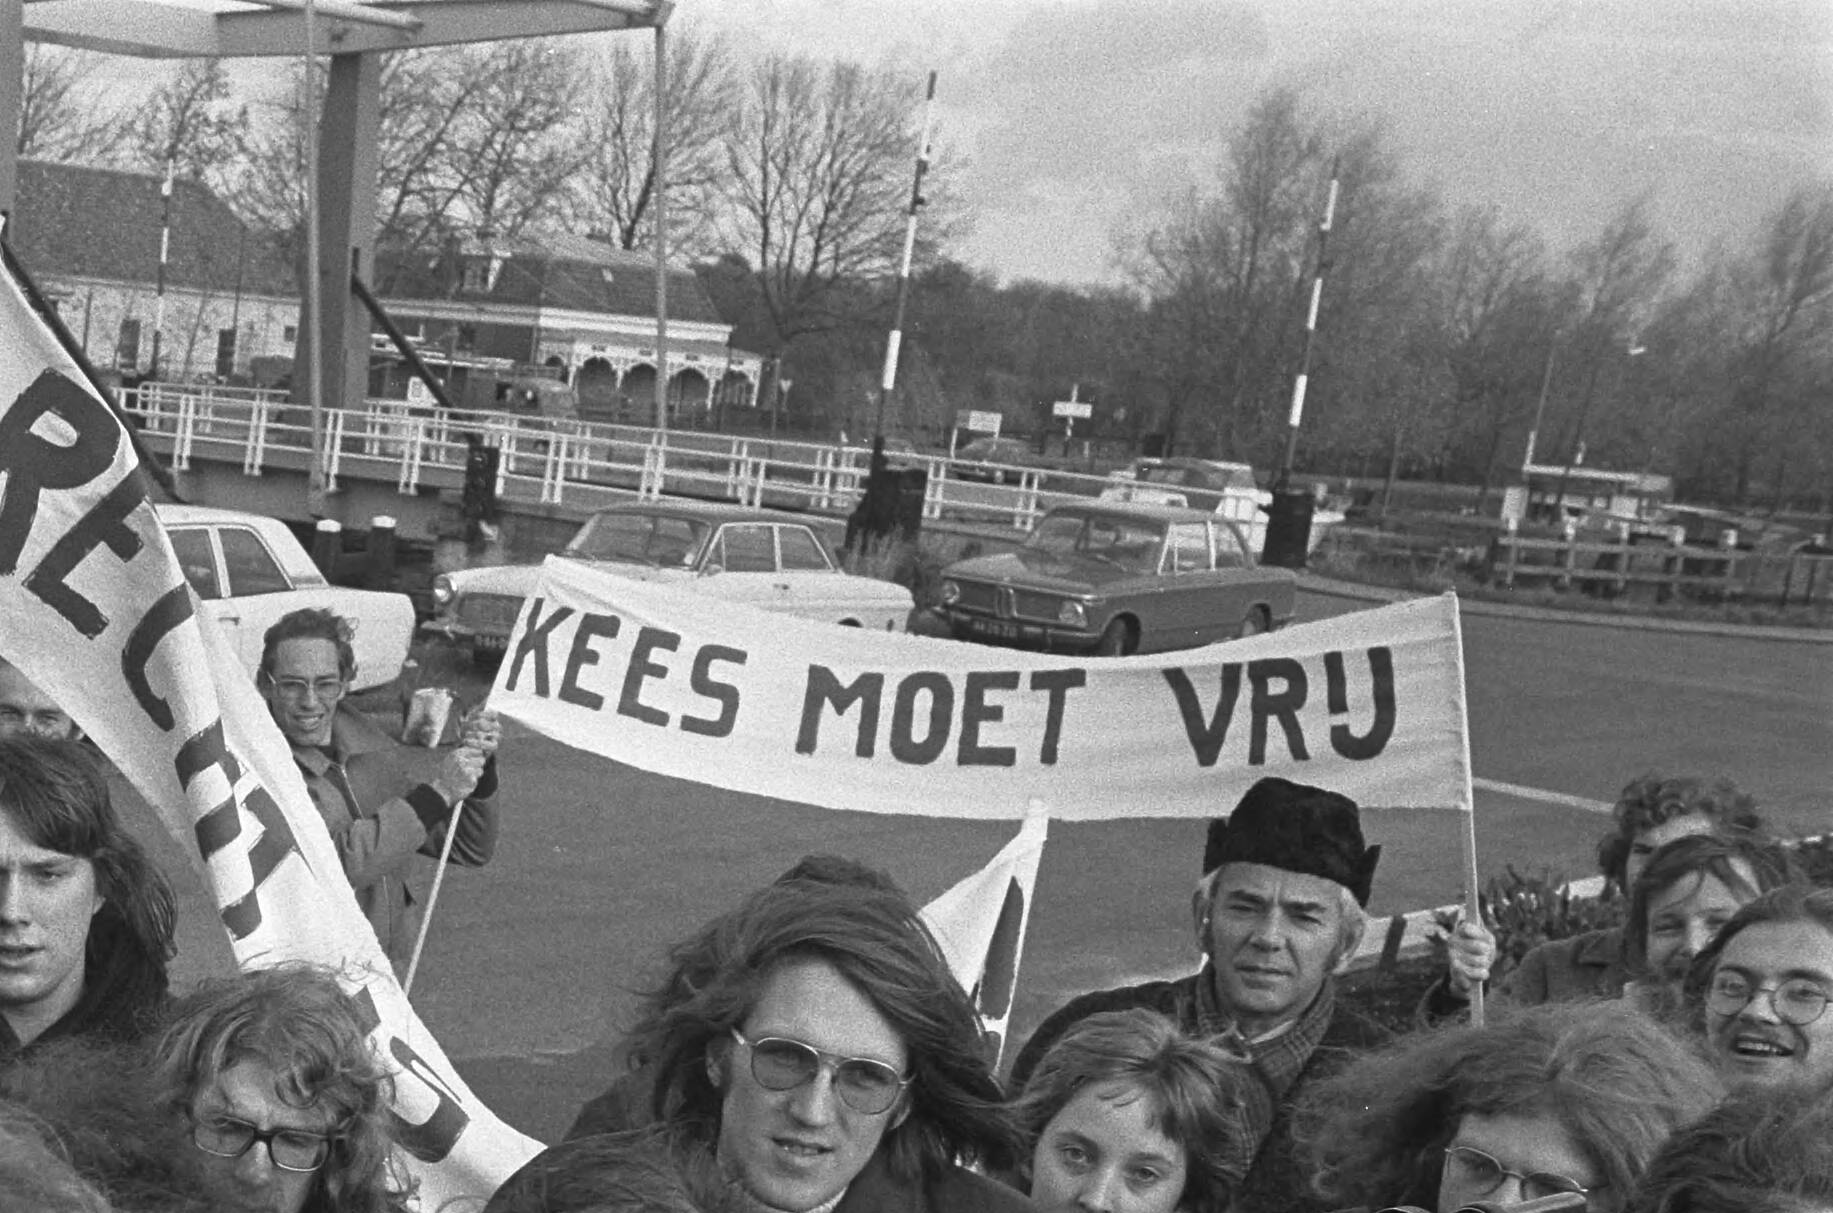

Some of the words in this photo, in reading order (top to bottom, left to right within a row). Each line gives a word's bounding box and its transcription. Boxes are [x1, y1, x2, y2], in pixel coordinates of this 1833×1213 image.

[506, 597, 748, 738] KEES
[794, 665, 1087, 768] MOET
[1159, 645, 1398, 768] VRIJ
